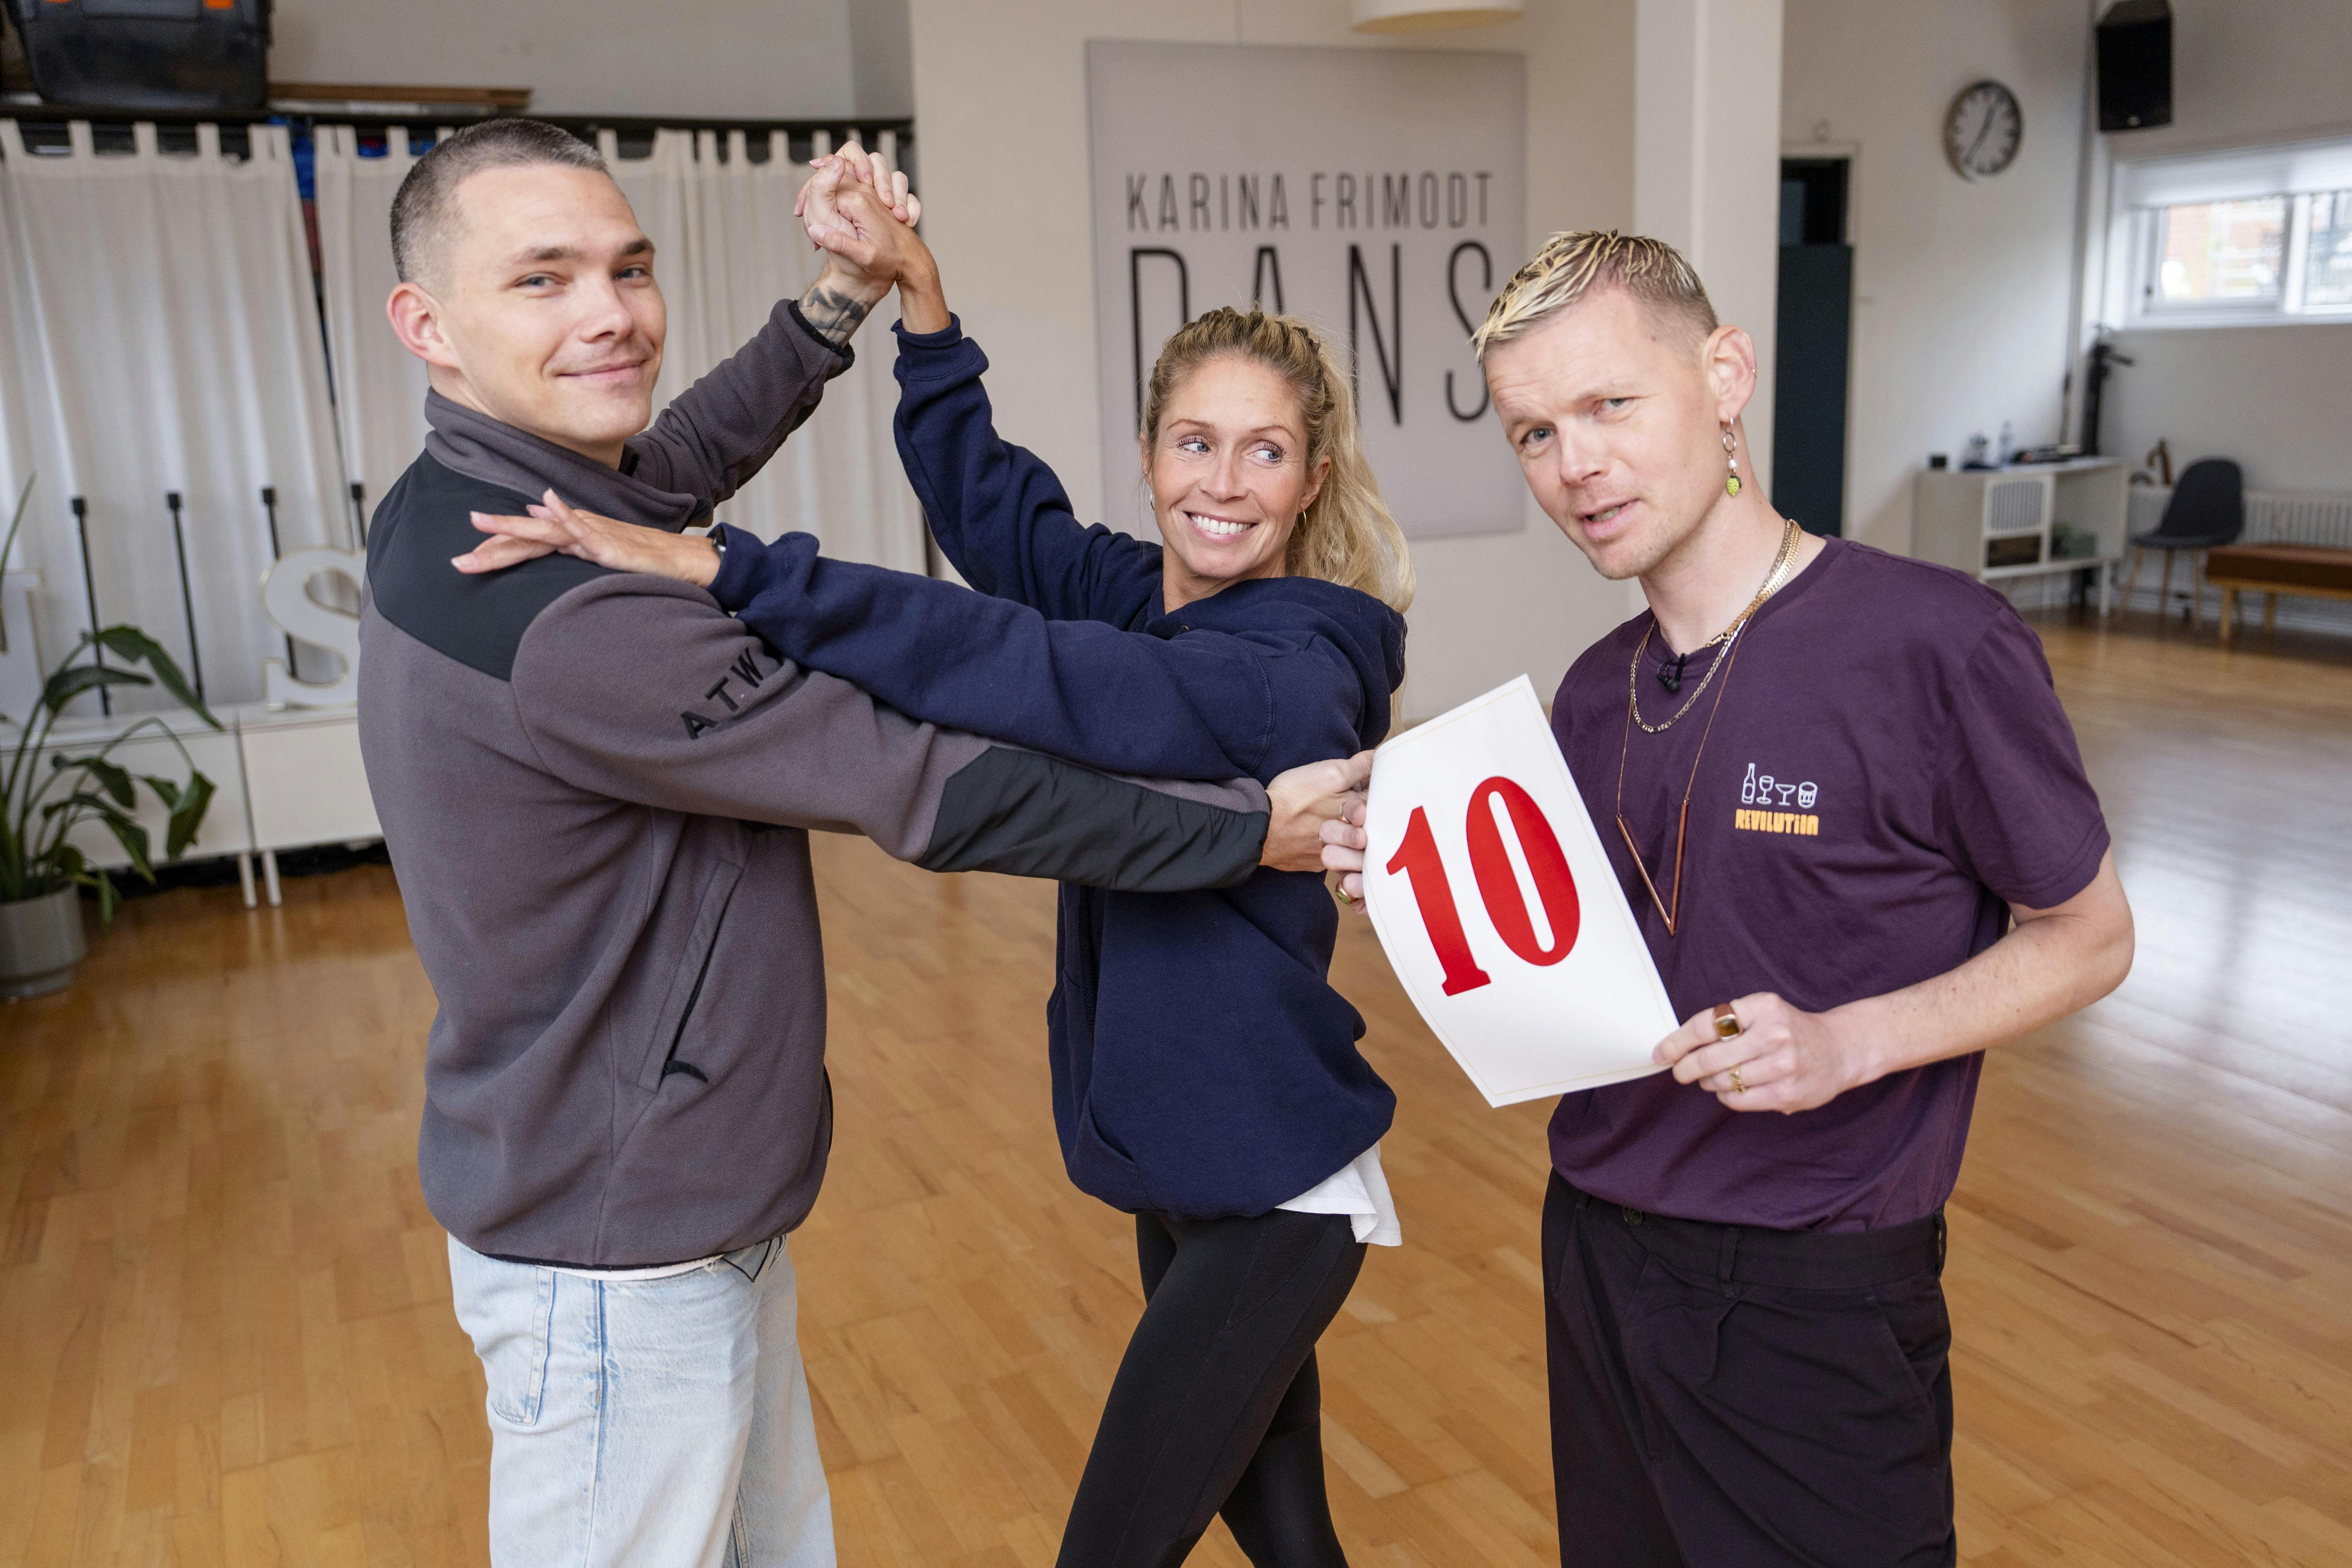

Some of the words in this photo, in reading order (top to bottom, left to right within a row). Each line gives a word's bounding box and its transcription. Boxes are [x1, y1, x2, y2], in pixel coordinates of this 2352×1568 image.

[1125, 171, 1290, 231] KARINA
[1310, 169, 1494, 230] FRIMODT
[1385, 776, 1581, 996] 10
